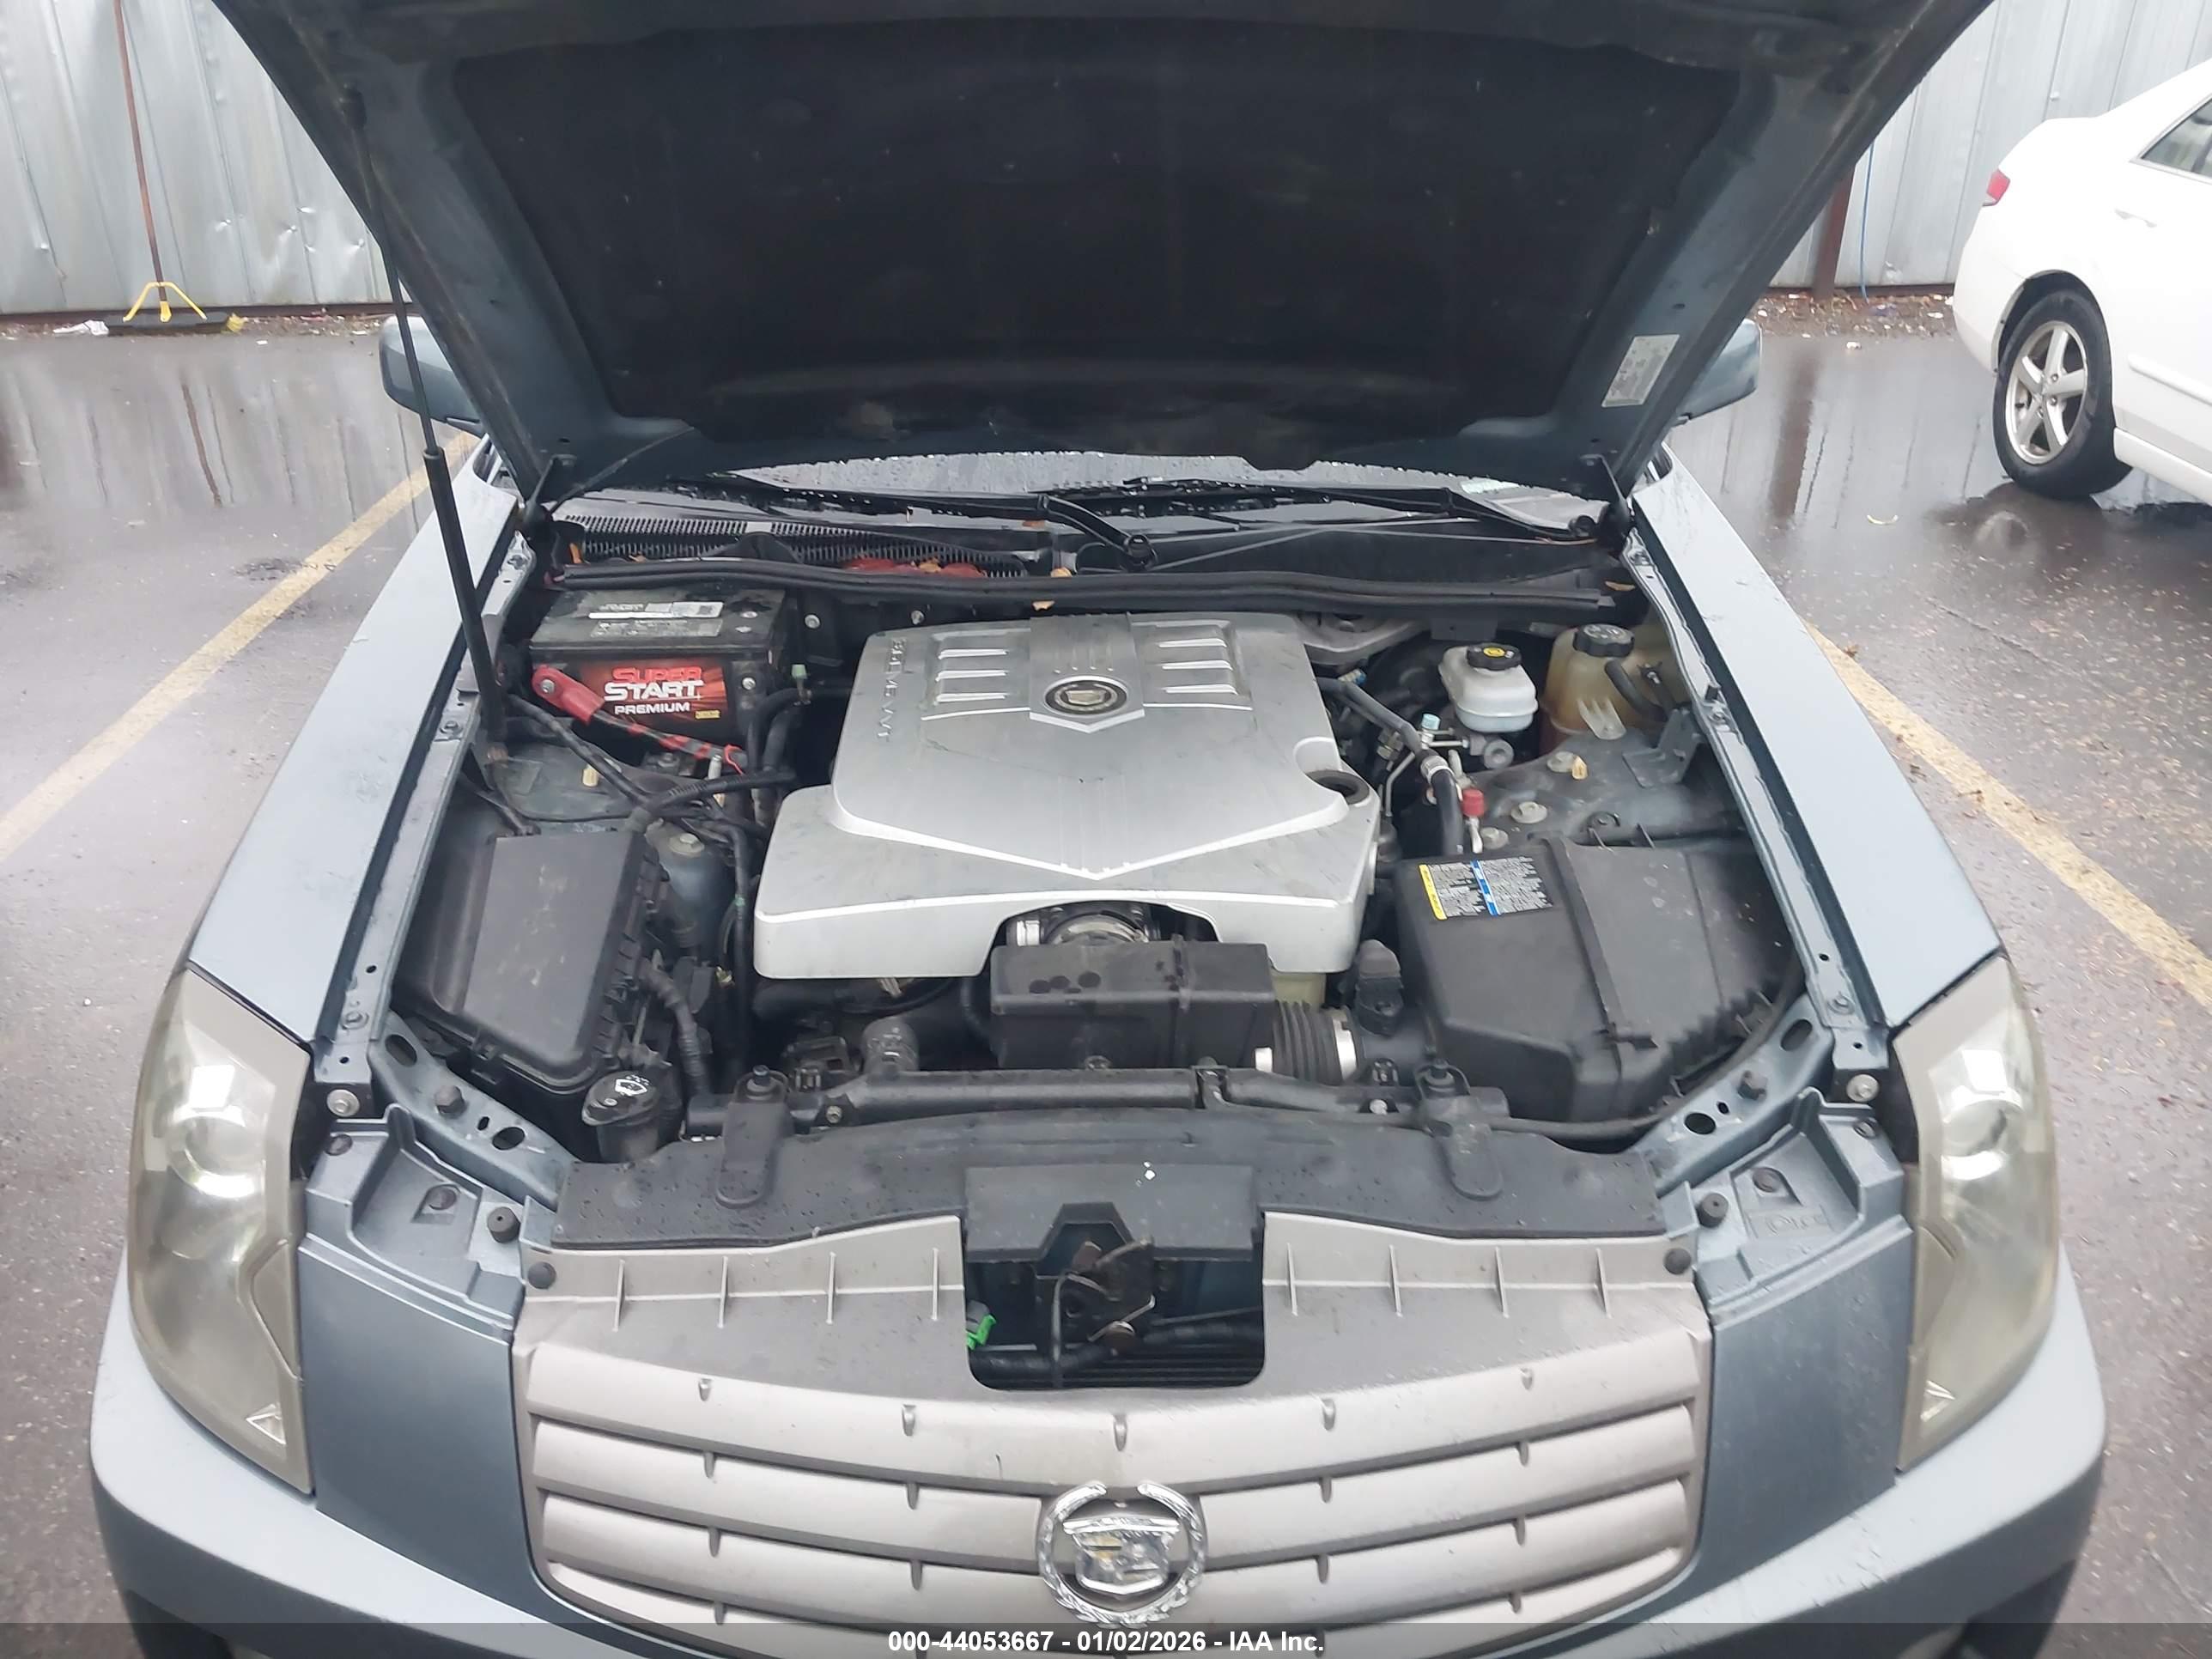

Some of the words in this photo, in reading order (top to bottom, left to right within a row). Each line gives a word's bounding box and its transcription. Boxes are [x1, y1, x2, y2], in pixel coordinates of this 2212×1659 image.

[612, 666, 702, 683] SUPER
[604, 679, 704, 701] START
[614, 702, 690, 715] PREMIUM
